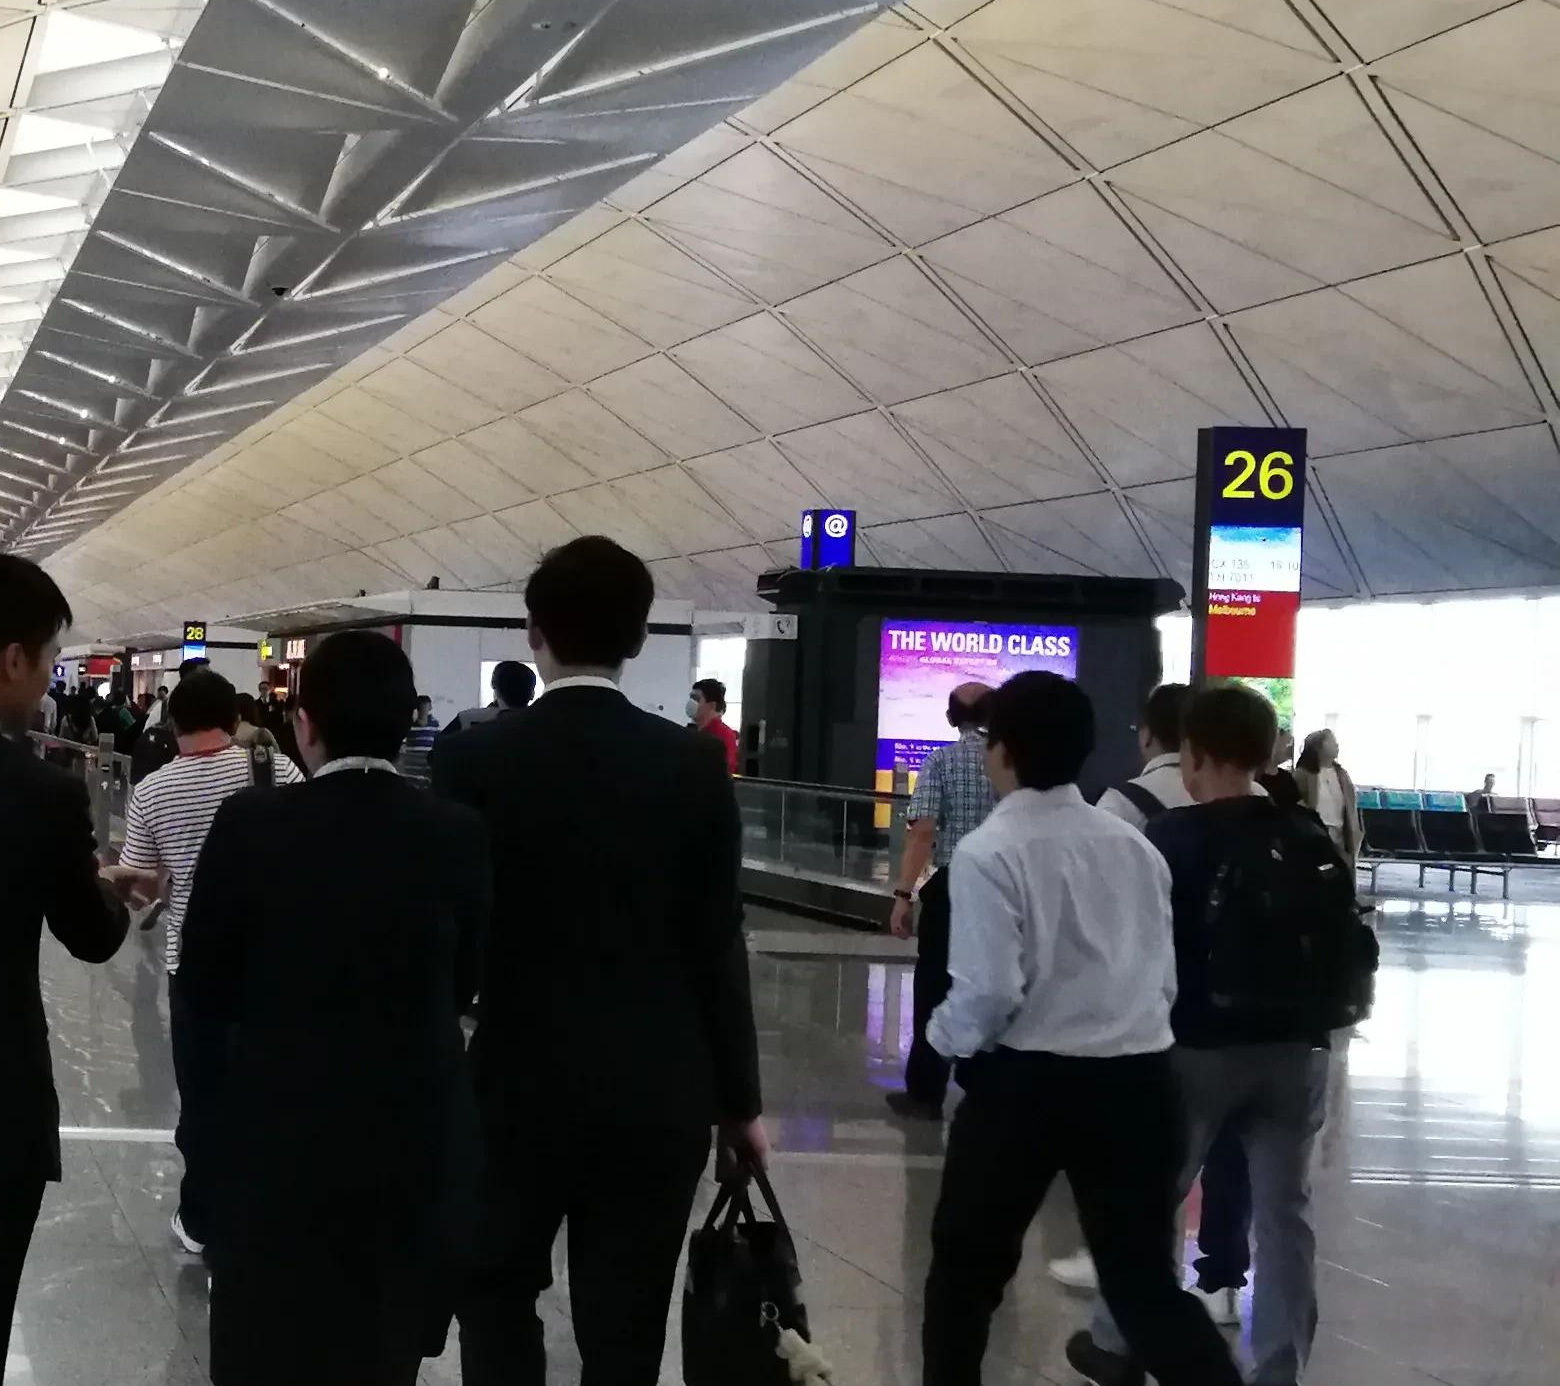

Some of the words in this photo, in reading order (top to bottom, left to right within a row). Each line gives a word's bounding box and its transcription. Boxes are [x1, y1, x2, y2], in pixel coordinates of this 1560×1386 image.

[1222, 450, 1294, 500] 26
[186, 626, 204, 640] 28
[888, 629, 927, 651] THE
[930, 632, 1003, 654] WORLD
[1008, 634, 1071, 656] CLASS
